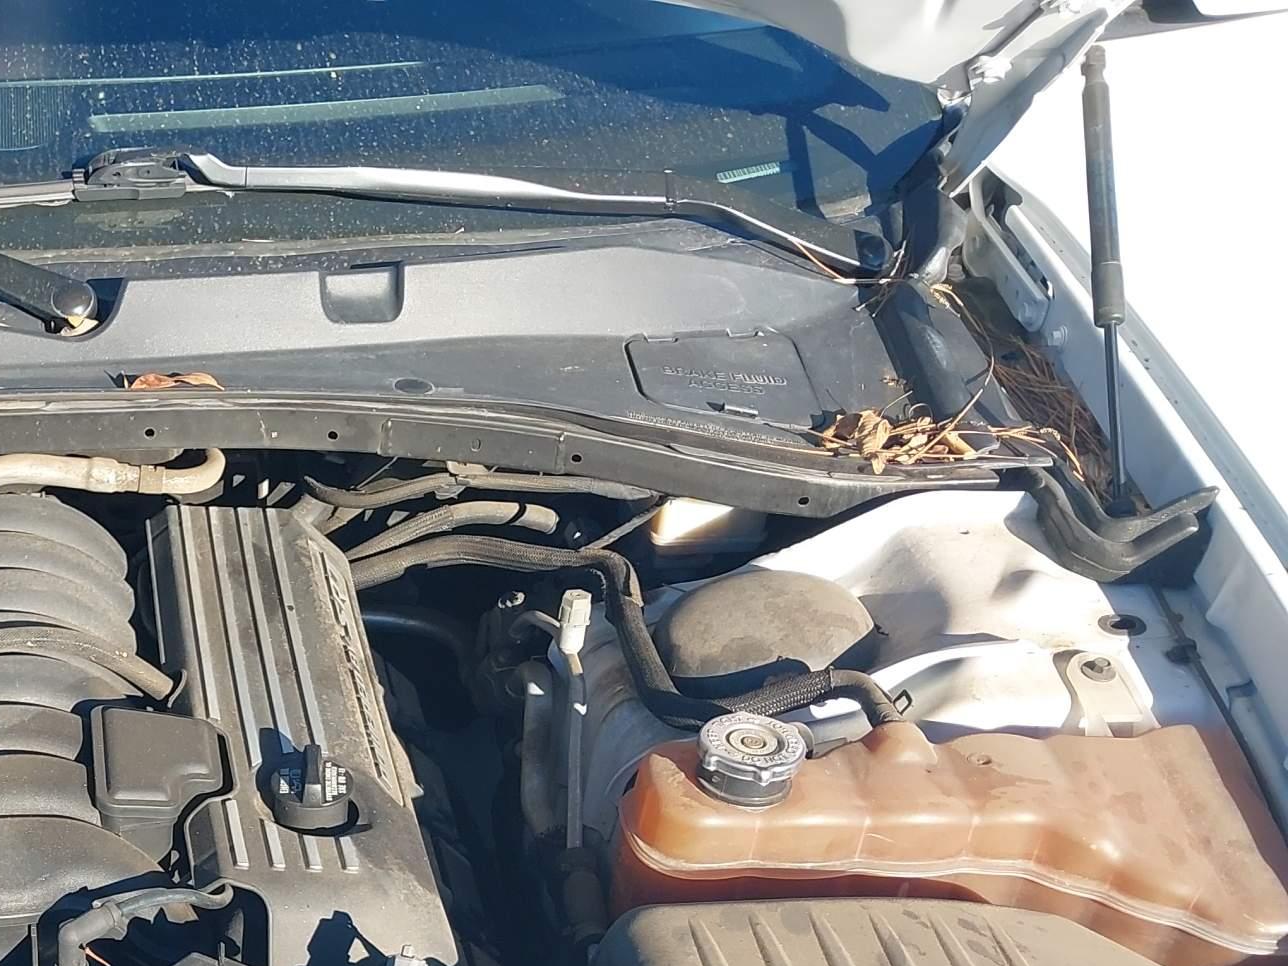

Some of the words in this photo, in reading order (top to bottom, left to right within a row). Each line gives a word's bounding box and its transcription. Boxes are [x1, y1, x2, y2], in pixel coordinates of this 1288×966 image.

[662, 366, 727, 380] BRAKE
[729, 372, 788, 386] FLUID
[688, 379, 766, 395] ACCESS
